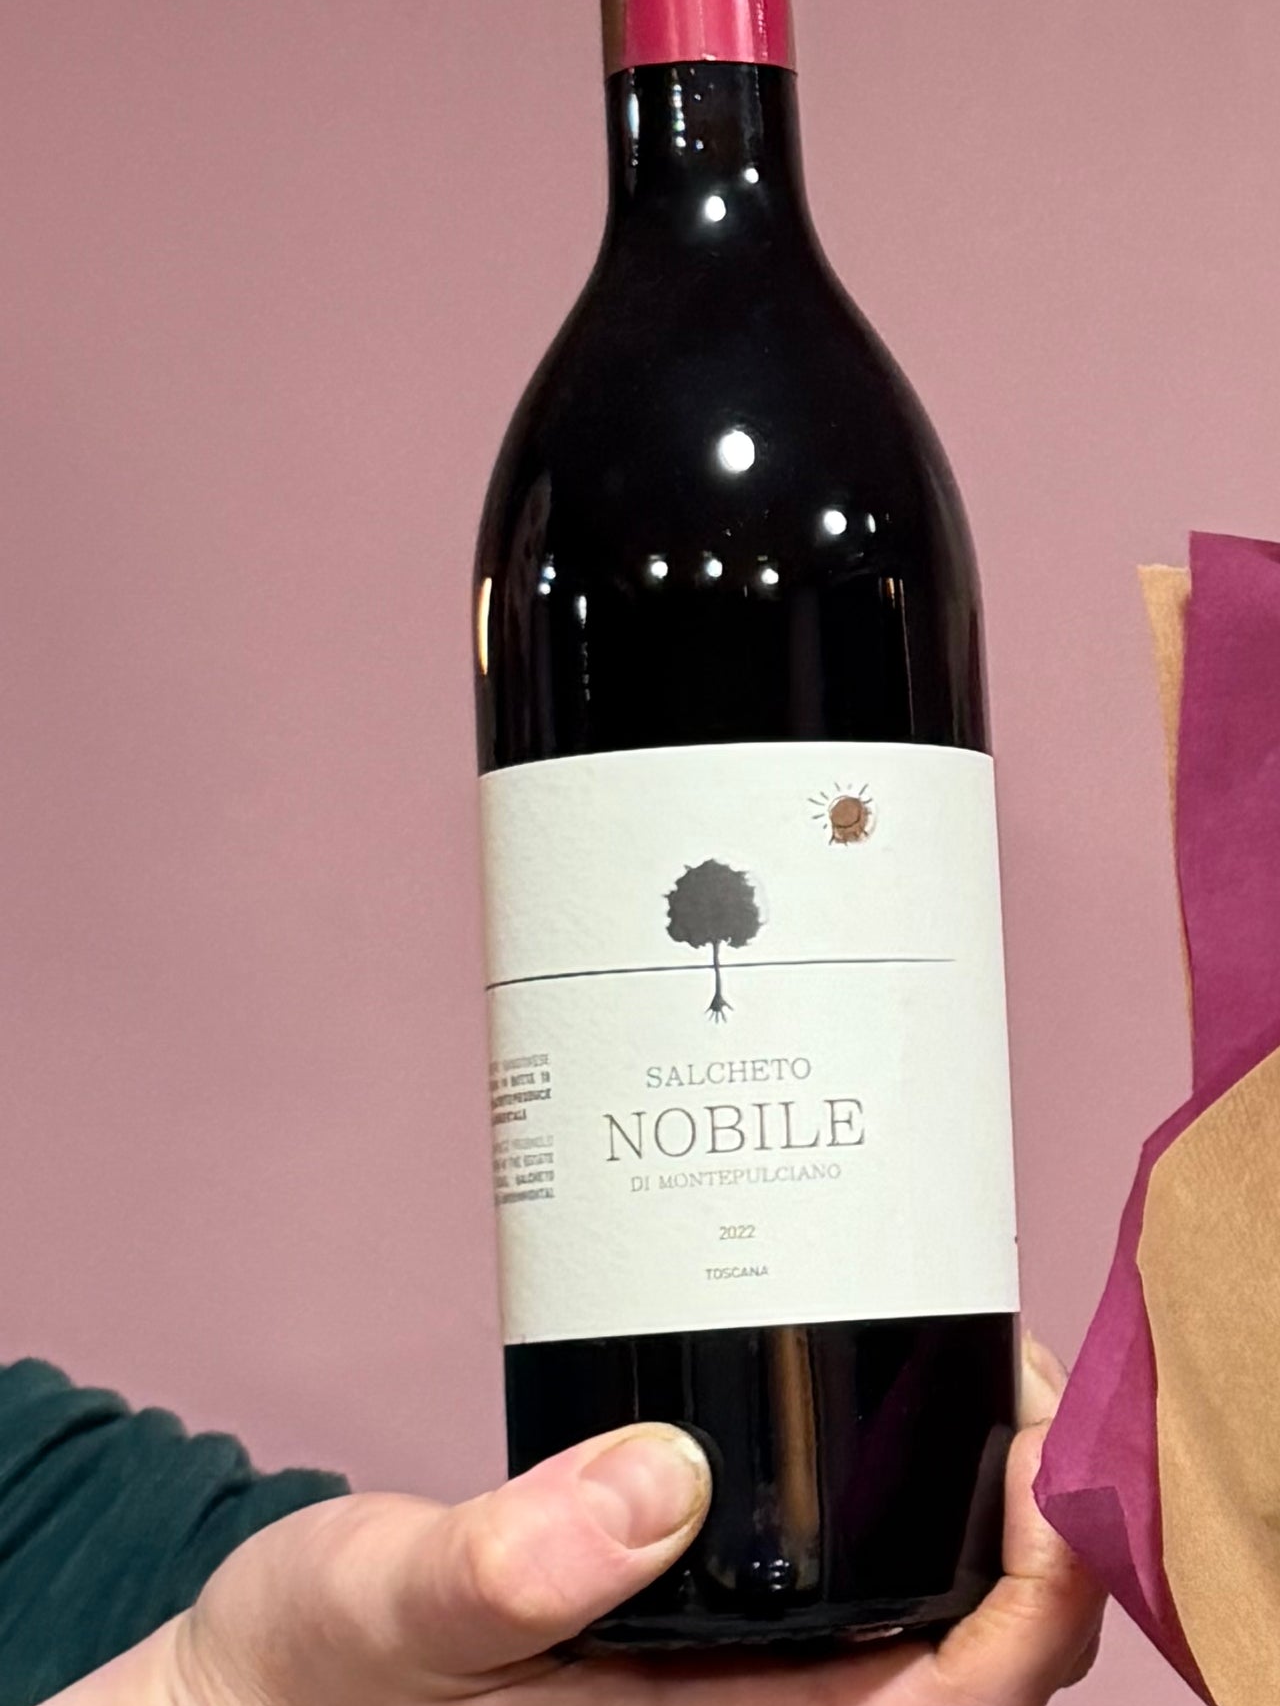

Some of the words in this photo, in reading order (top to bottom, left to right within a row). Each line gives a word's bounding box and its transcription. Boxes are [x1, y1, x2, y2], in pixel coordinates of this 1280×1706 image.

[646, 1057, 811, 1089] SALCHETO
[602, 1098, 866, 1161] NOBILE
[630, 1175, 650, 1192] DI
[658, 1163, 842, 1190] MONTEPULCIANO
[719, 1224, 756, 1240] 2022
[705, 1265, 768, 1280] TOSCANA
